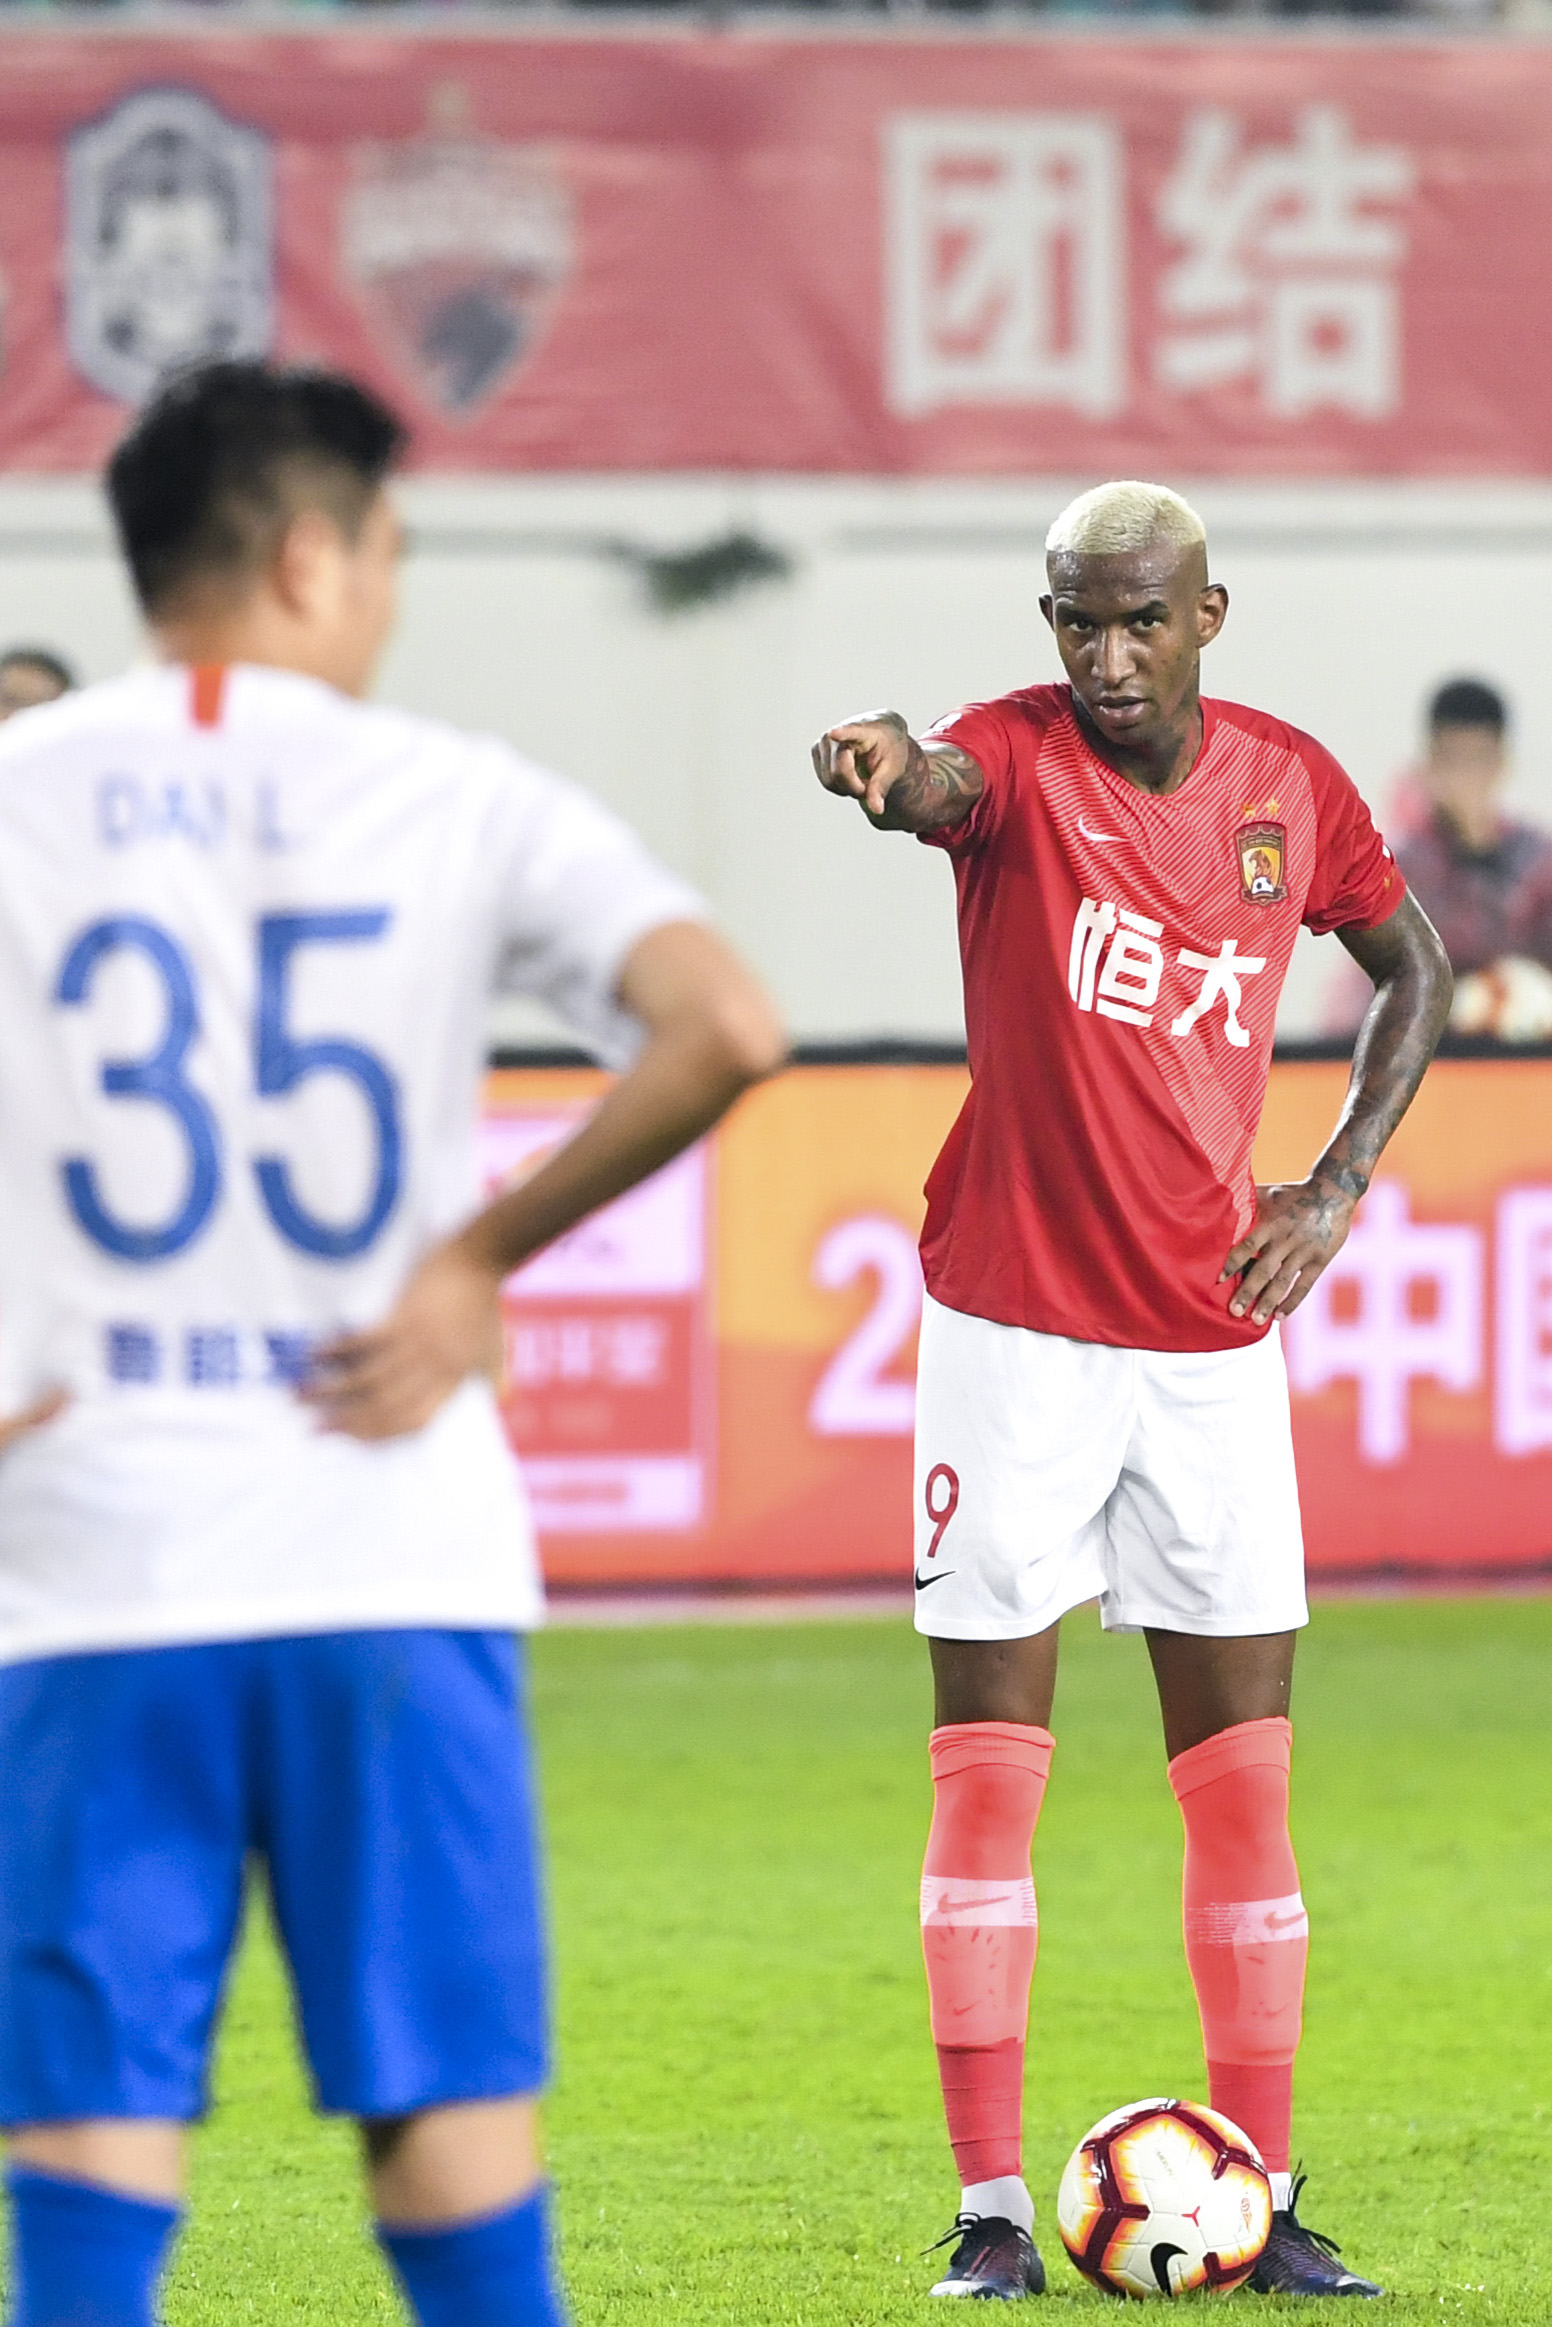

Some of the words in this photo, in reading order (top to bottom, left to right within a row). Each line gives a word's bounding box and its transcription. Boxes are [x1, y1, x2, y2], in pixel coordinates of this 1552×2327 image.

[885, 112, 1413, 418] 团结
[56, 903, 408, 1266] 35
[1068, 896, 1267, 1047] 恒大
[924, 1461, 960, 1559] 9
